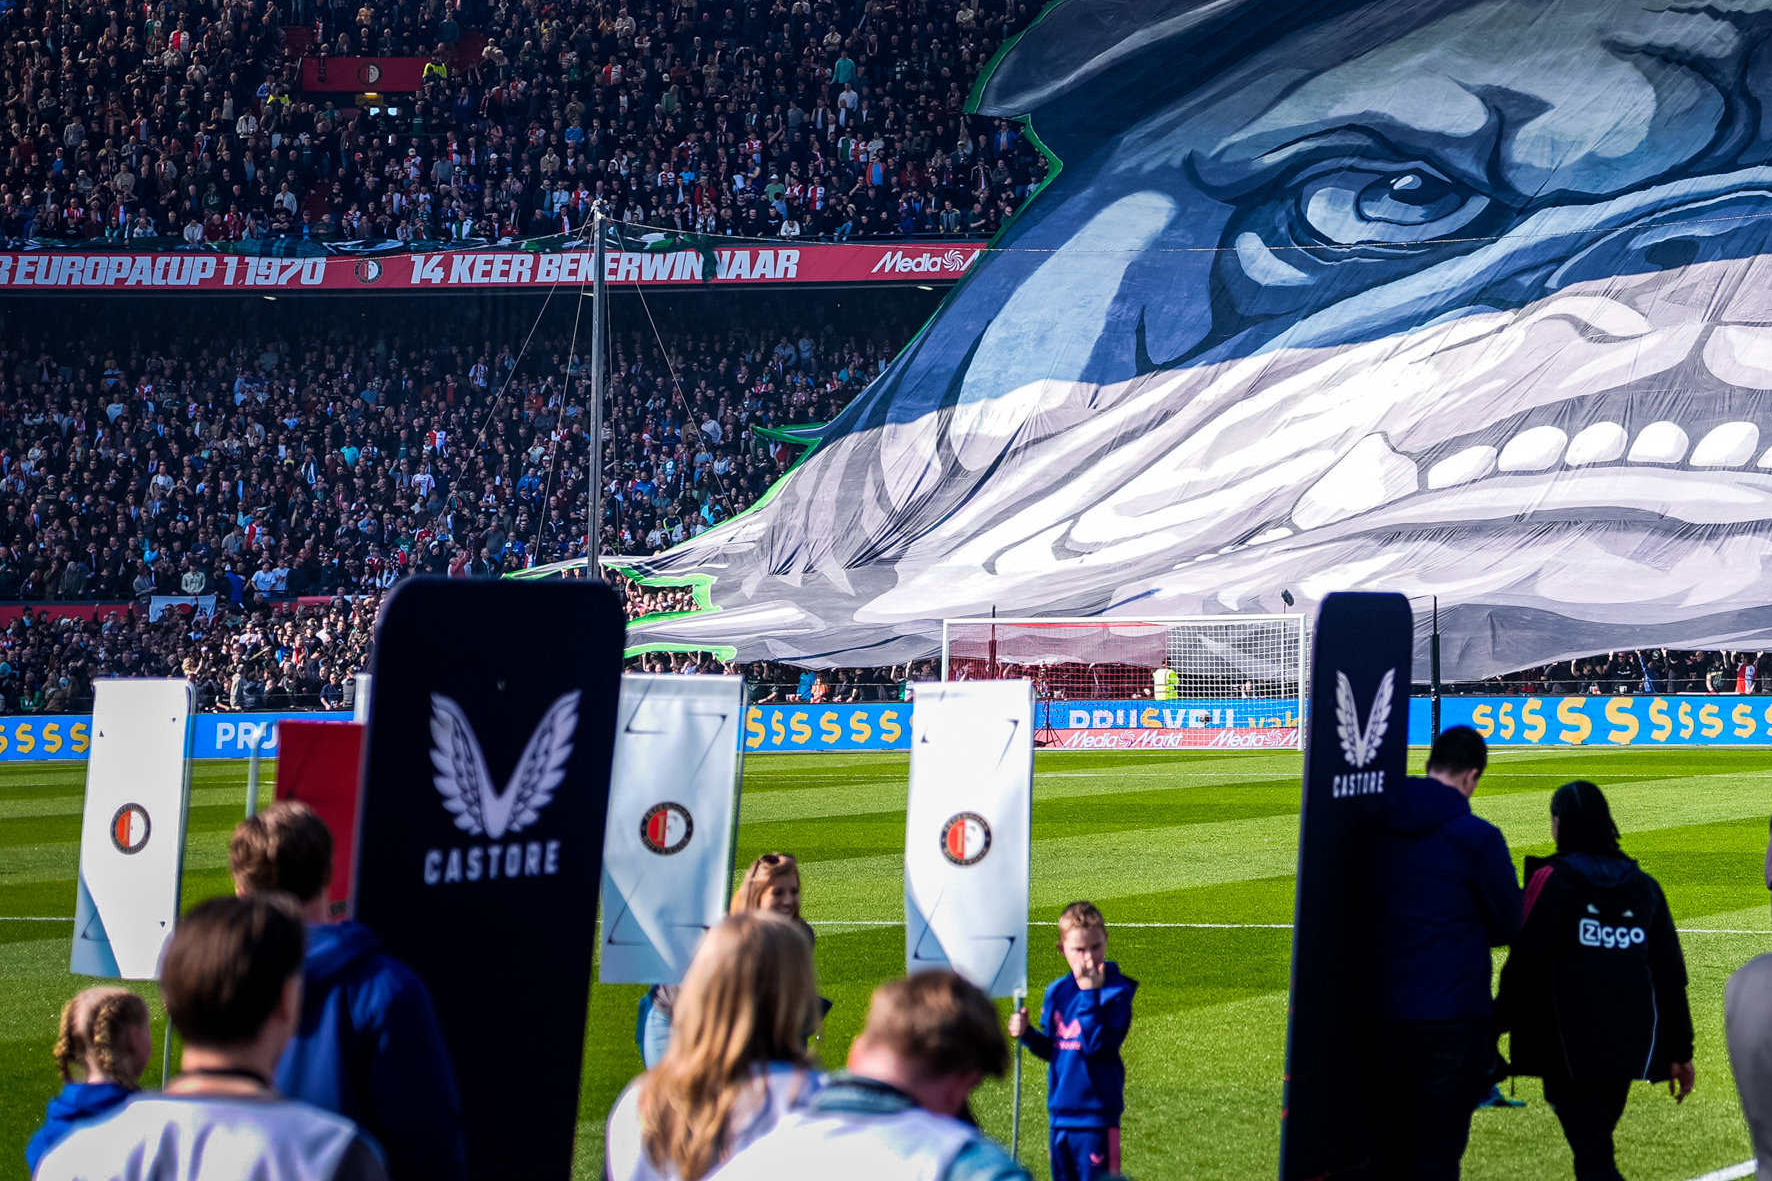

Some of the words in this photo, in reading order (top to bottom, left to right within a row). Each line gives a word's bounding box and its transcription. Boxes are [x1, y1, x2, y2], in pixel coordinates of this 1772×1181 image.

[12, 255, 217, 285] EUROPACUP
[244, 257, 327, 285] 1970
[410, 255, 444, 284] 14
[448, 253, 534, 283] KEER
[1332, 769, 1386, 799] CASTORE
[422, 839, 562, 887] CASTORE
